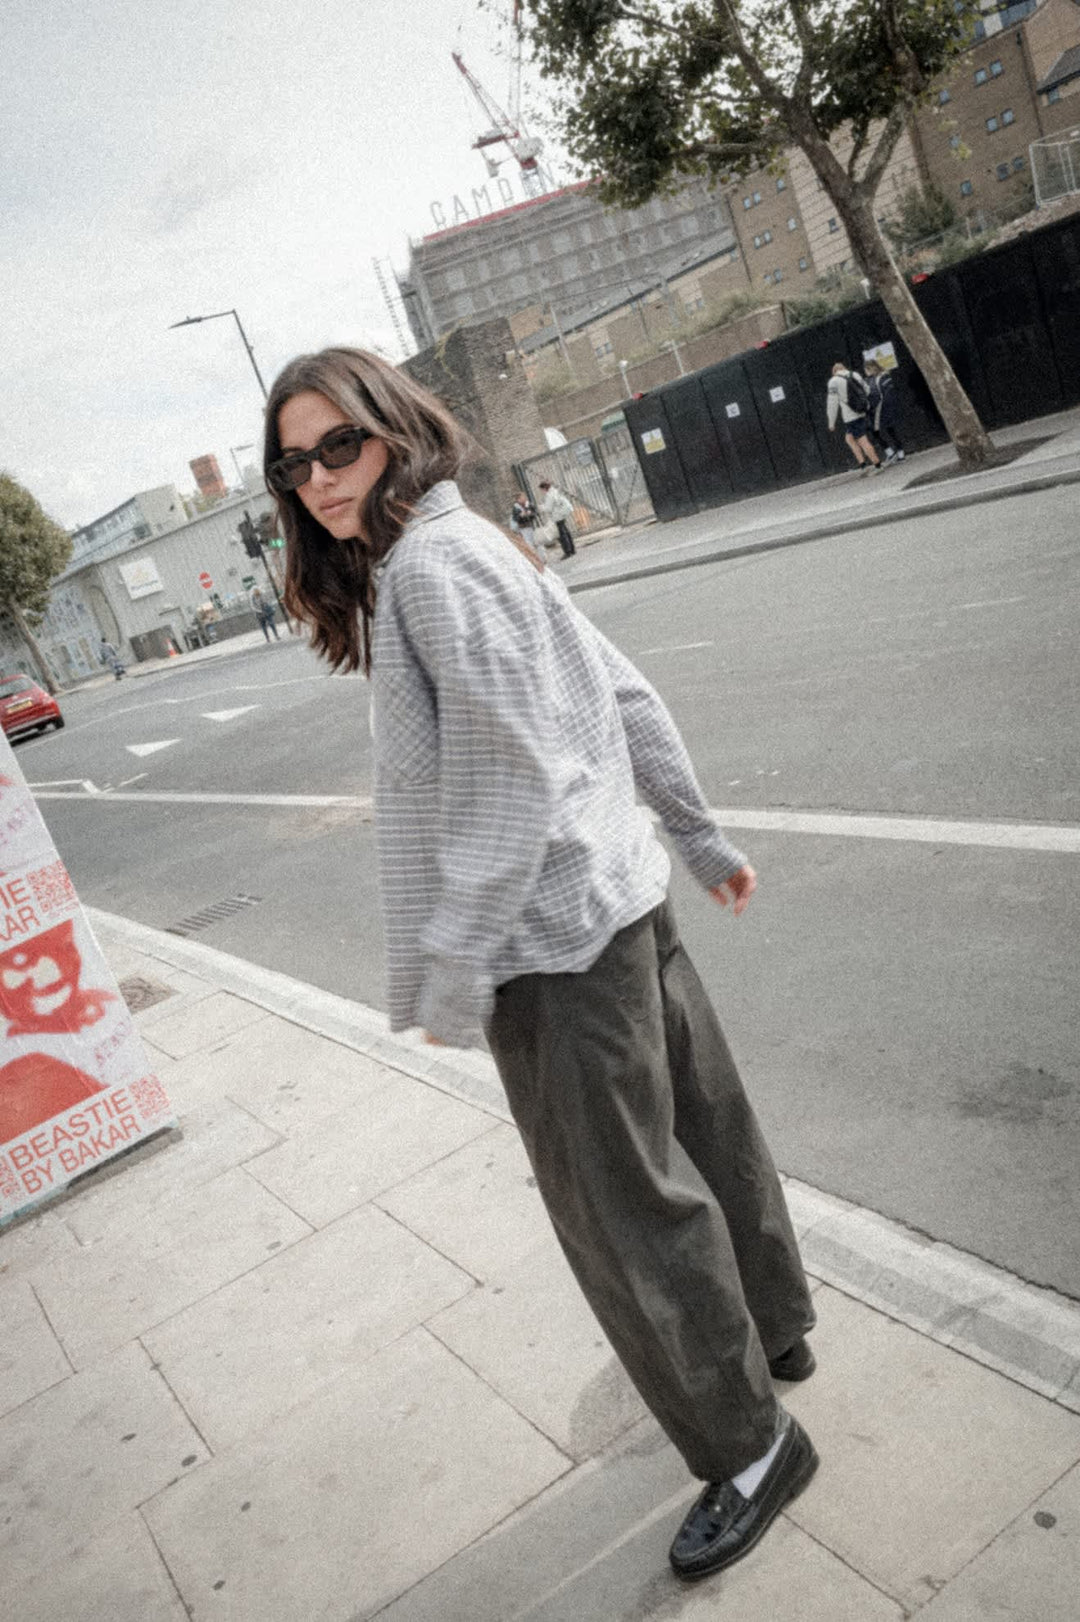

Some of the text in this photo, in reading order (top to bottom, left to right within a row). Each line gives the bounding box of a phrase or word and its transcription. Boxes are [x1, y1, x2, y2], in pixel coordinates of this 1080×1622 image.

[430, 163, 556, 226] CAMDN
[8, 1088, 132, 1171] BEASTIE
[21, 1114, 142, 1195] BY BAKAR
